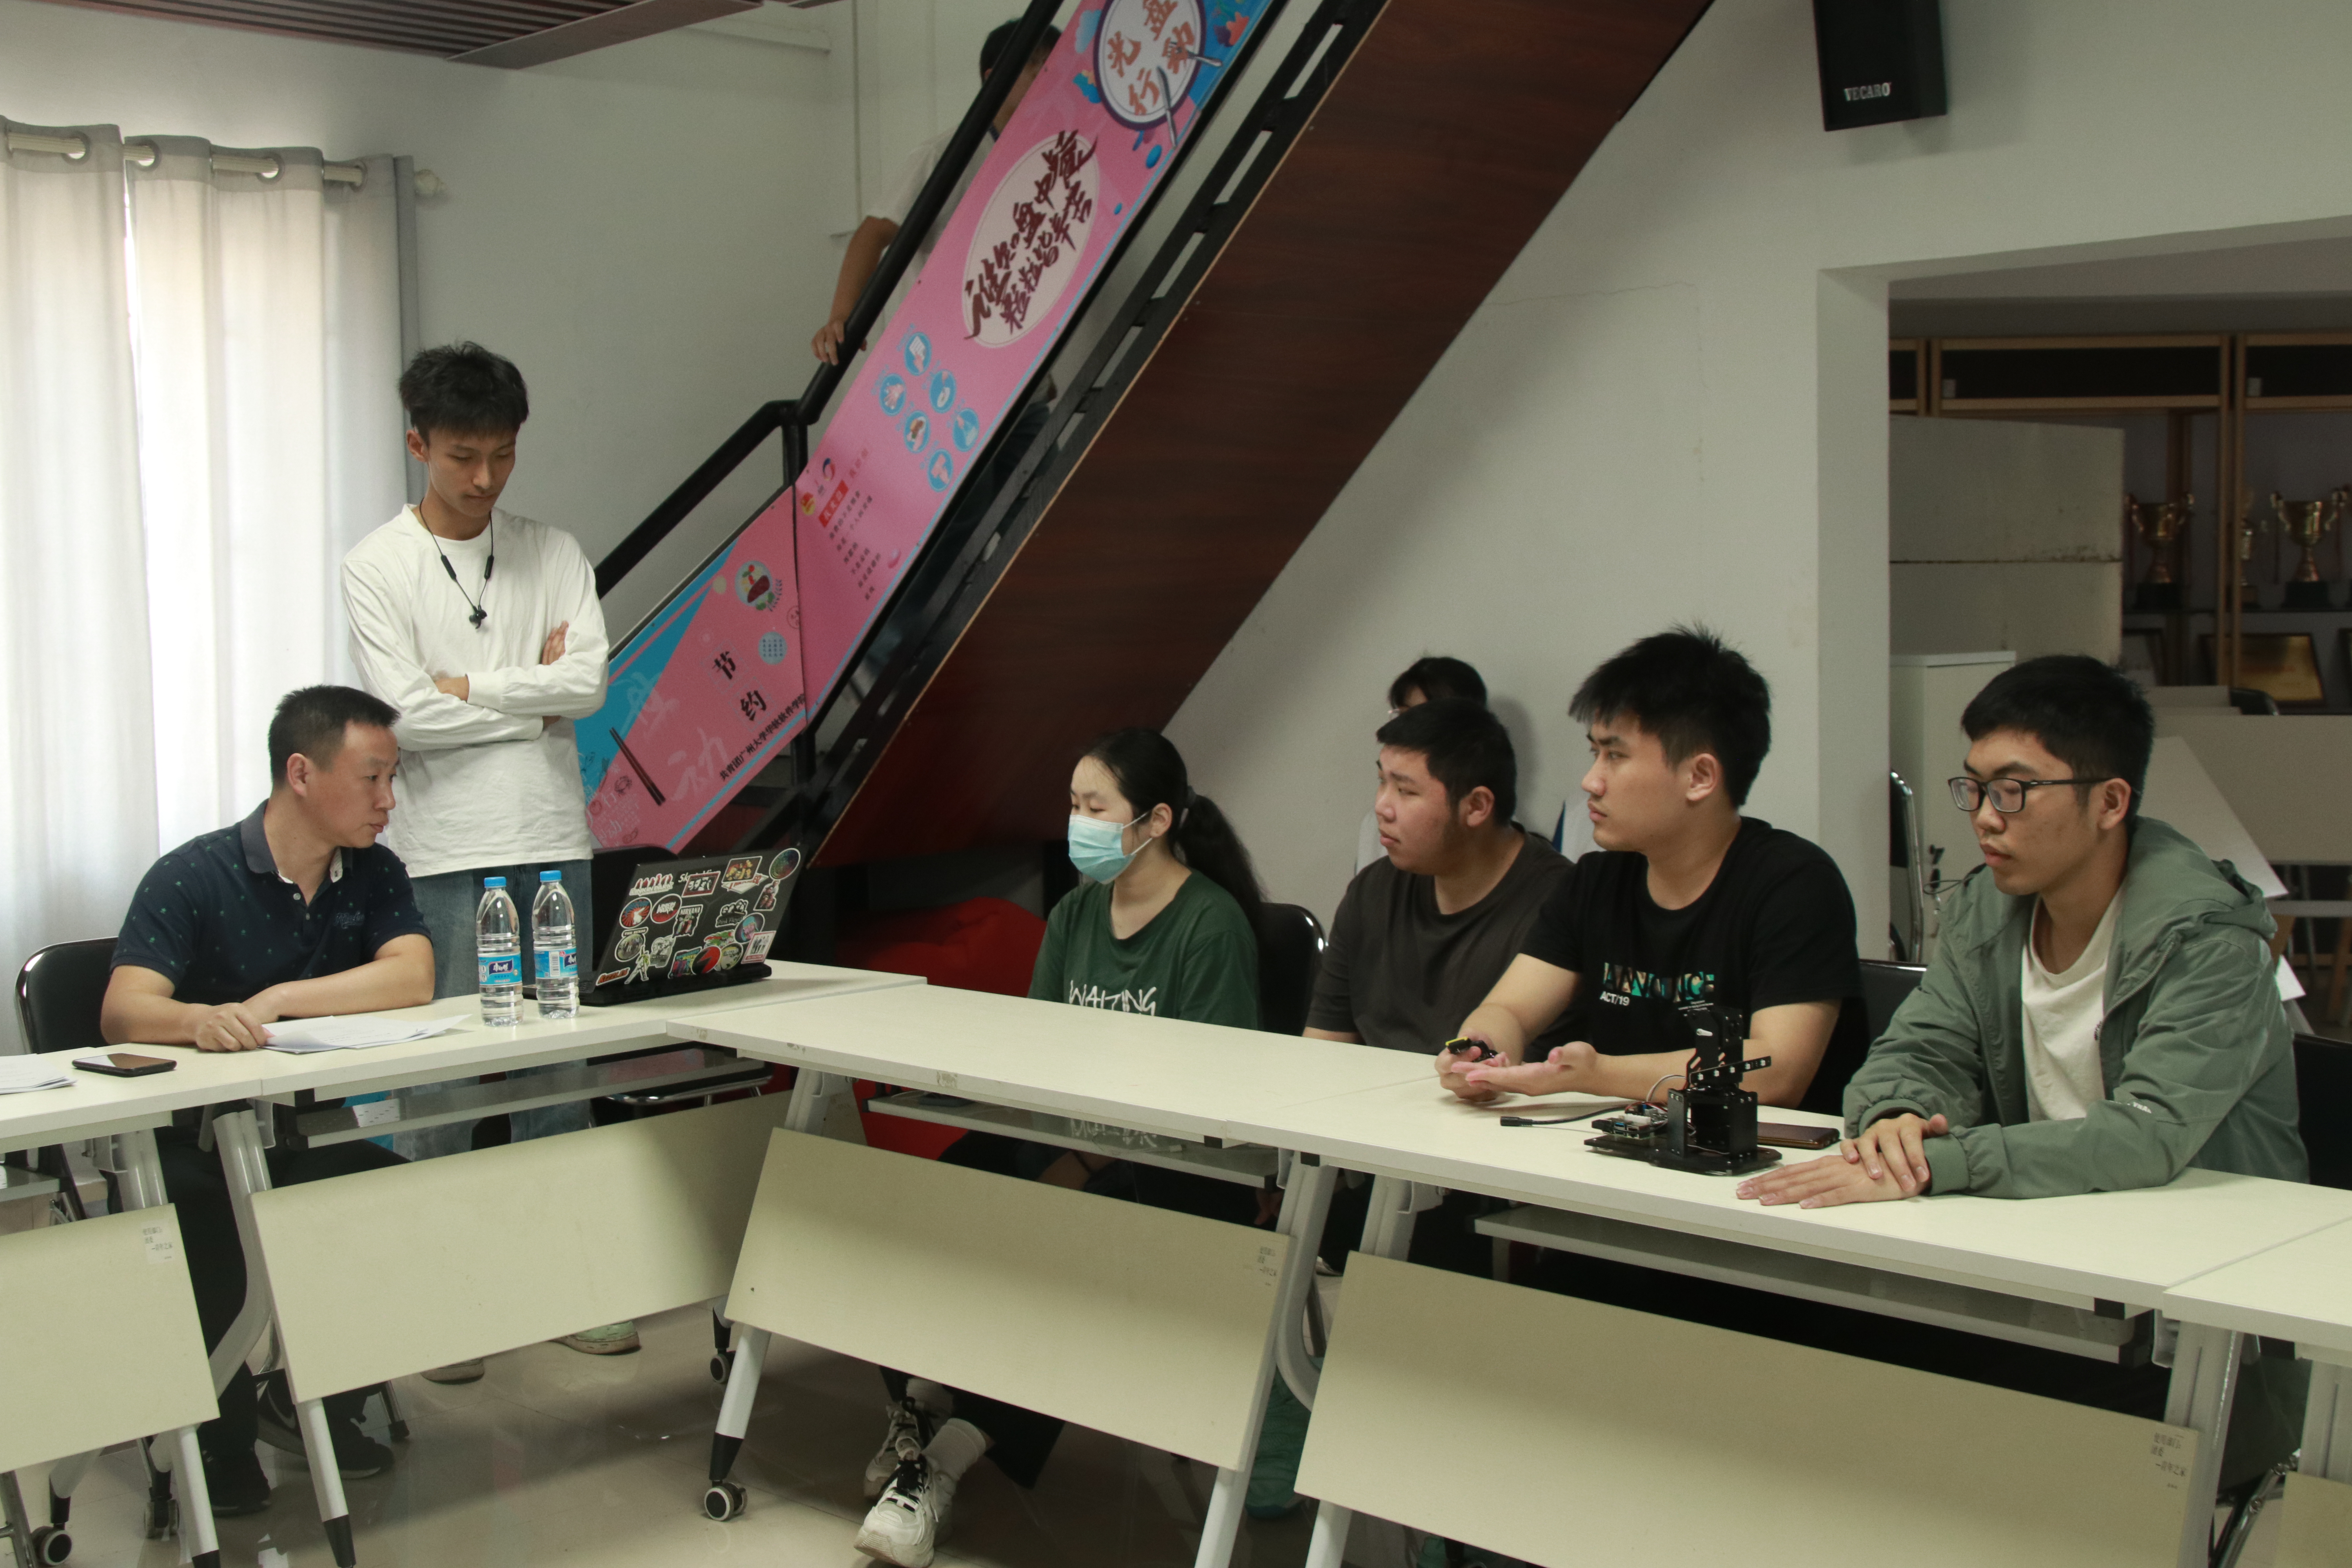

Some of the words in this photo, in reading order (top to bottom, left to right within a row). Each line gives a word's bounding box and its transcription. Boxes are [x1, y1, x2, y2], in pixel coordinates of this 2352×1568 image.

[1844, 82, 1891, 101] VECARO
[1000, 180, 1092, 334] 粒粒皆辛苦
[1599, 991, 1630, 1006] ACT/19
